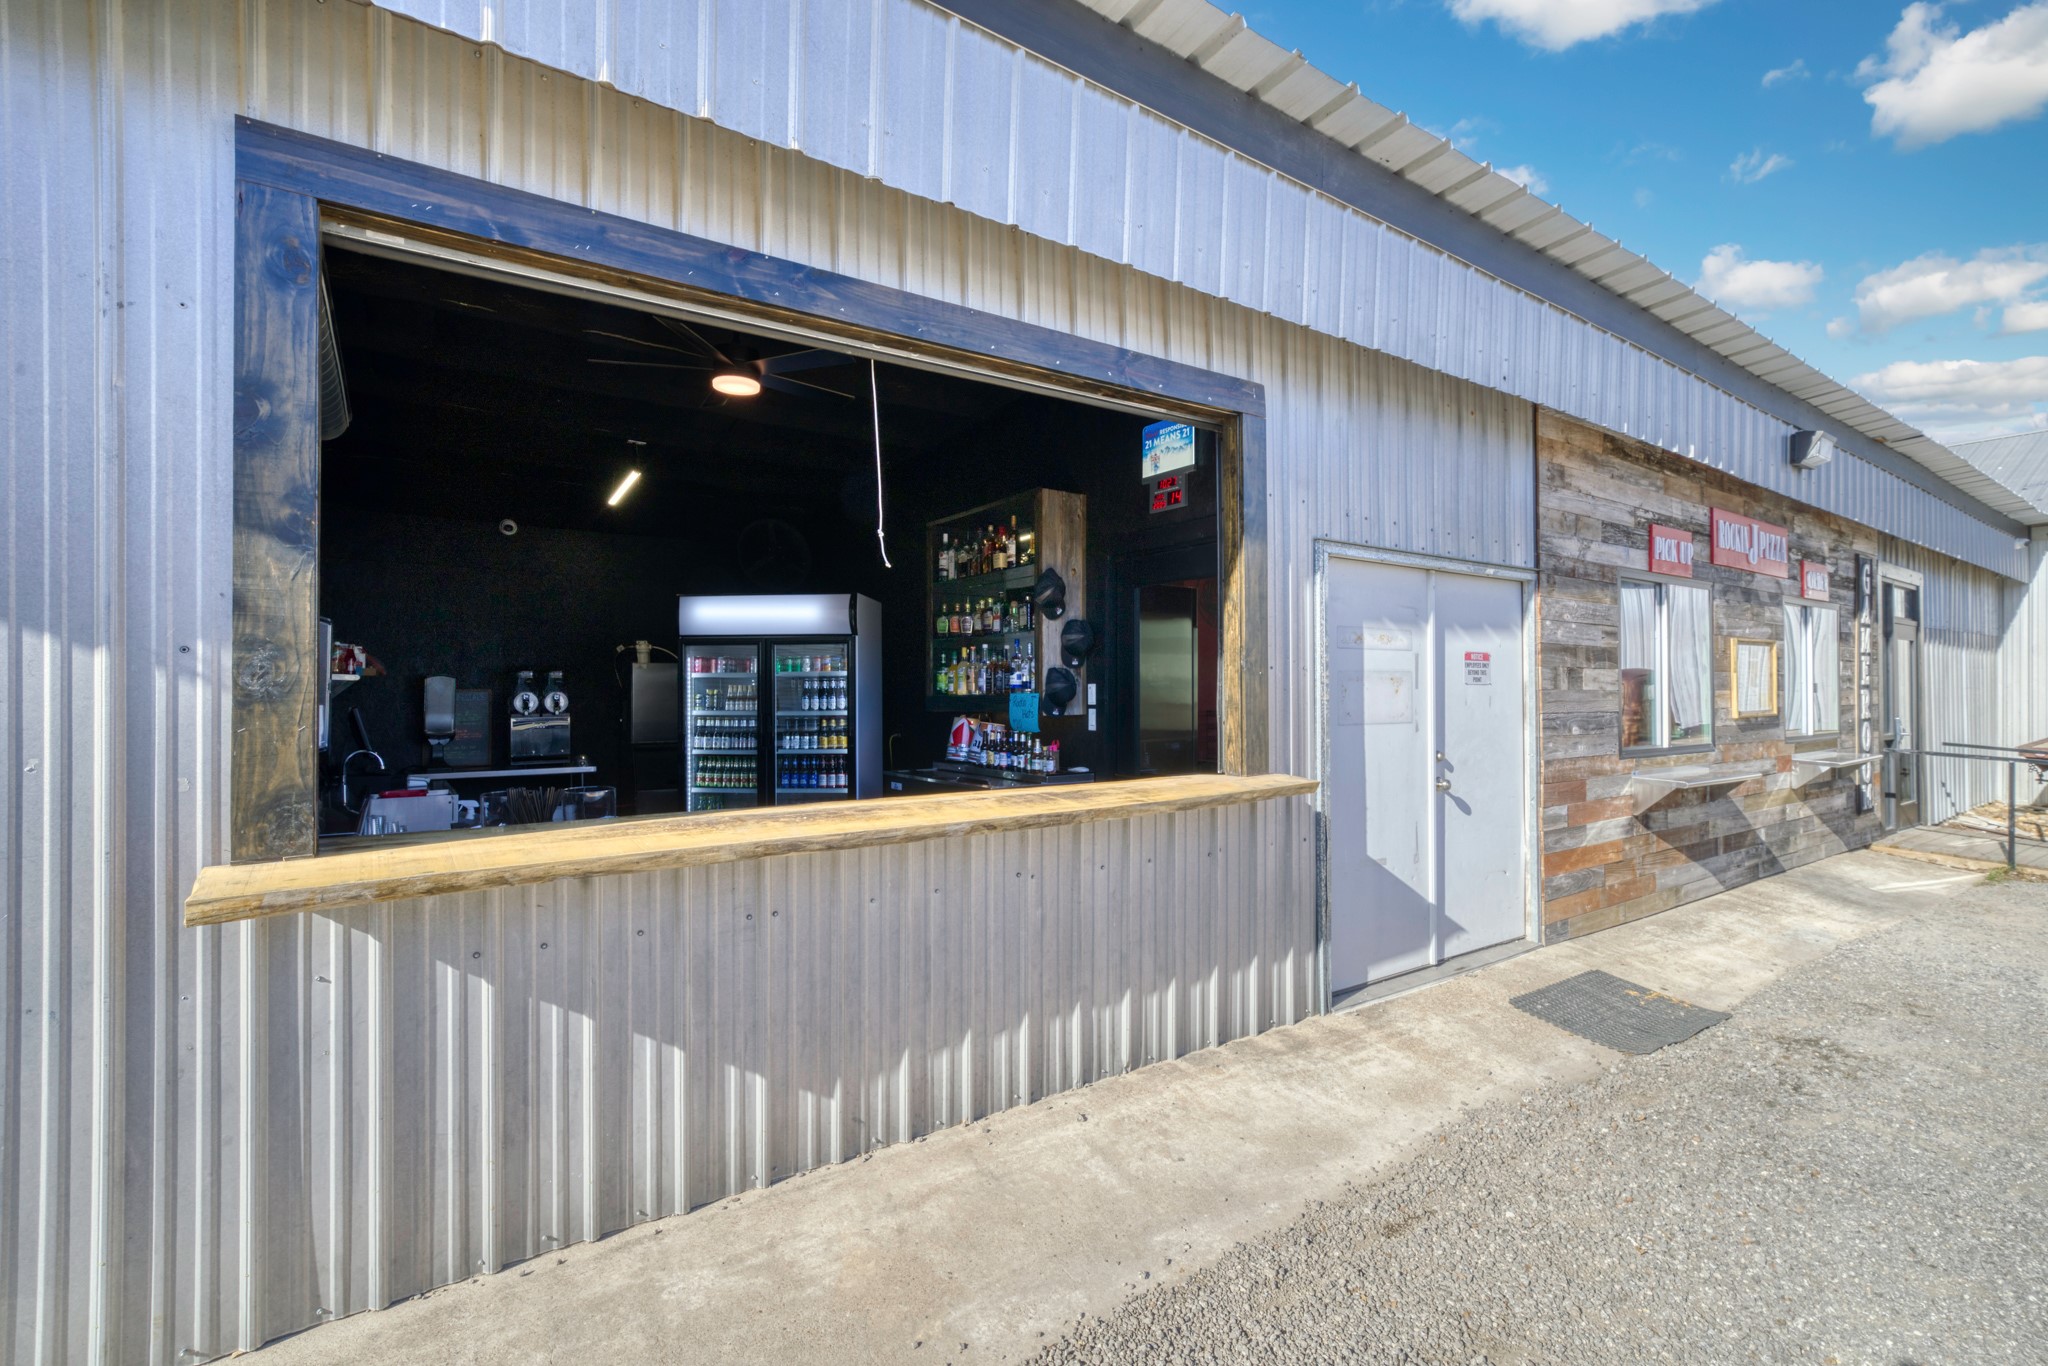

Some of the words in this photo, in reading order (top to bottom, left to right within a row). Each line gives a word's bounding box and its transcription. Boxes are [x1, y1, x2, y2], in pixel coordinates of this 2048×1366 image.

[1145, 440, 1152, 449] 21
[1153, 430, 1180, 447] MEANS
[1182, 427, 1190, 438] 21
[1654, 536, 1678, 562] PICK
[1679, 541, 1694, 565] UP
[1717, 519, 1749, 554] ROCKIN
[1747, 523, 1759, 565] J
[1759, 530, 1788, 563] PIZZA
